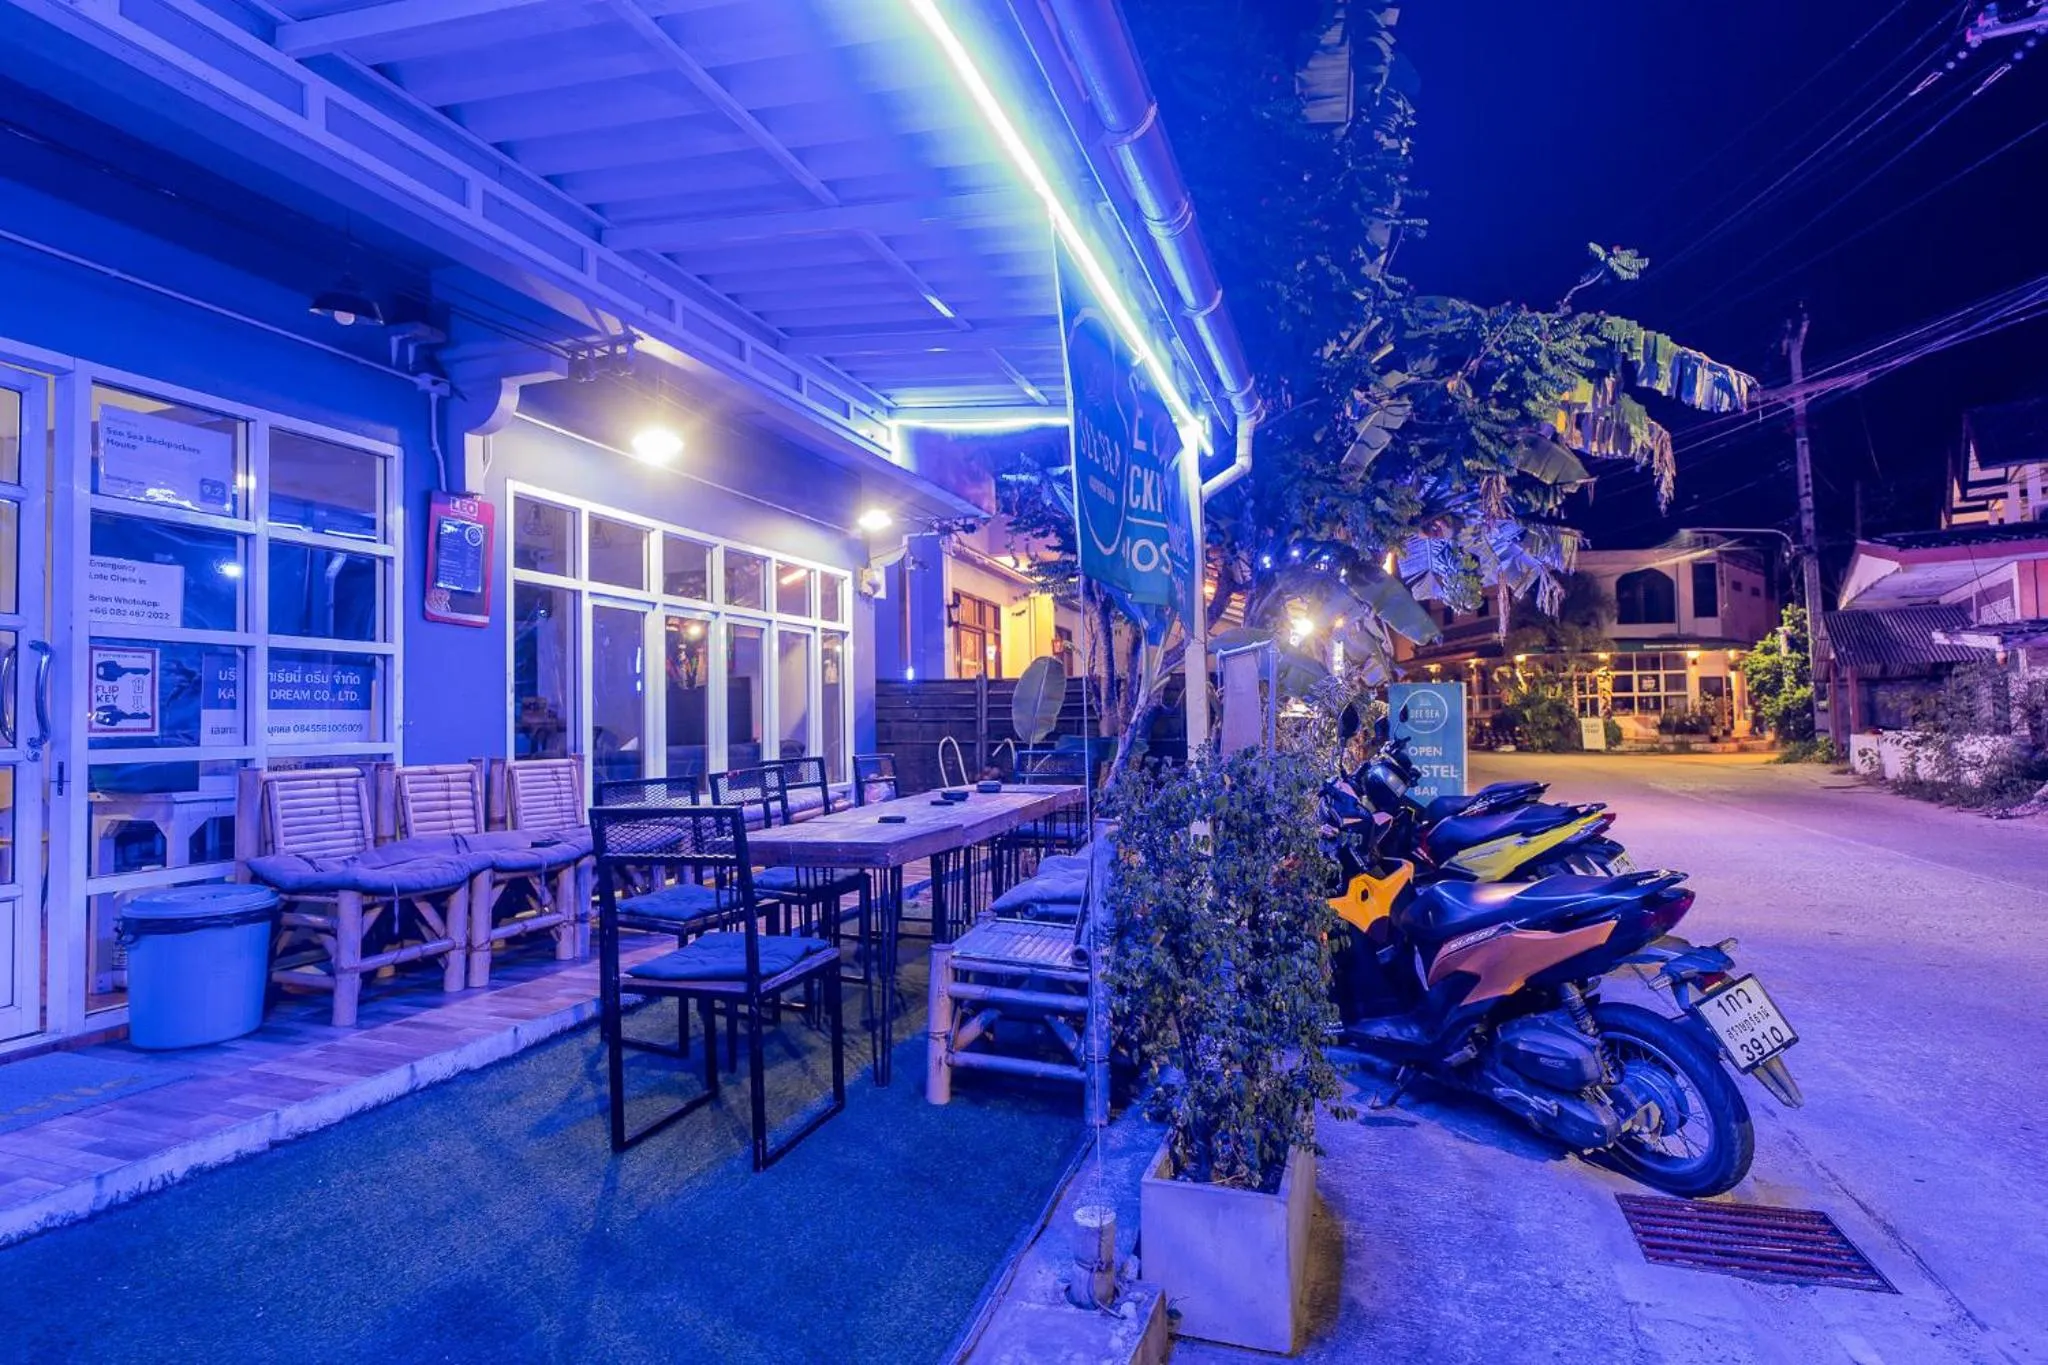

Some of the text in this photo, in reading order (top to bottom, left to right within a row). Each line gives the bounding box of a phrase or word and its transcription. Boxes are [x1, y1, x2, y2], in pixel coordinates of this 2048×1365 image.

[95, 684, 119, 694] FLIP
[96, 694, 119, 704] KEY
[270, 689, 311, 701] DREAM
[338, 690, 360, 702] LTD.
[1408, 746, 1443, 757] OPEN
[1413, 785, 1439, 797] BAR
[1740, 1025, 1785, 1062] 3910
